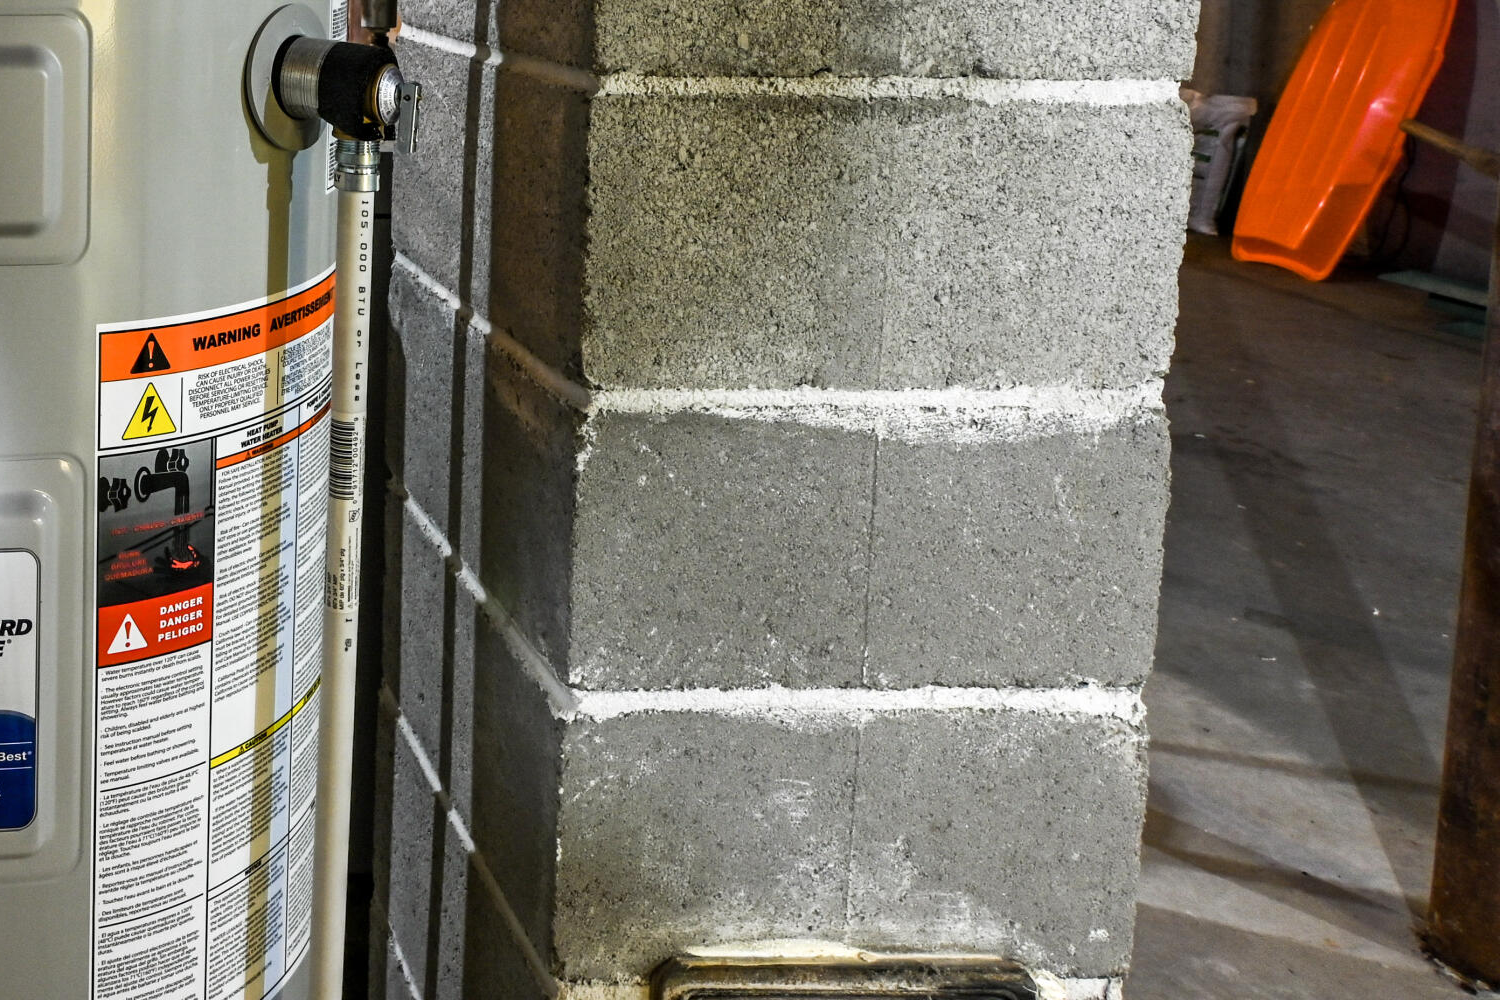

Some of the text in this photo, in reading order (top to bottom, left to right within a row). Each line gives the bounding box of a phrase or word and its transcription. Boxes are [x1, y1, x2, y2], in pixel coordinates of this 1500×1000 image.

[357, 286, 366, 316] BTU
[193, 323, 261, 351] WARNING
[211, 371, 218, 379] OF
[219, 364, 246, 376] ELECTRICAL
[248, 358, 264, 367] SHOCK
[188, 382, 223, 395] DISCONNECT
[224, 380, 233, 388] ALL
[234, 375, 250, 384] POWER
[209, 376, 225, 385] CAUSE
[227, 372, 243, 381] INJURY
[189, 392, 210, 402] BEFORE
[211, 386, 237, 396] SERVICING
[199, 404, 213, 413] ONLY
[215, 398, 239, 409] PROPERLY
[200, 407, 230, 419] PERSONNEL
[240, 426, 283, 448] WATER HEATER
[246, 419, 279, 438] HEAT PUMP
[160, 596, 203, 615] DANGER
[160, 610, 202, 628] DANGER
[158, 623, 203, 642] PELIGRO
[245, 732, 267, 750] CAUTION
